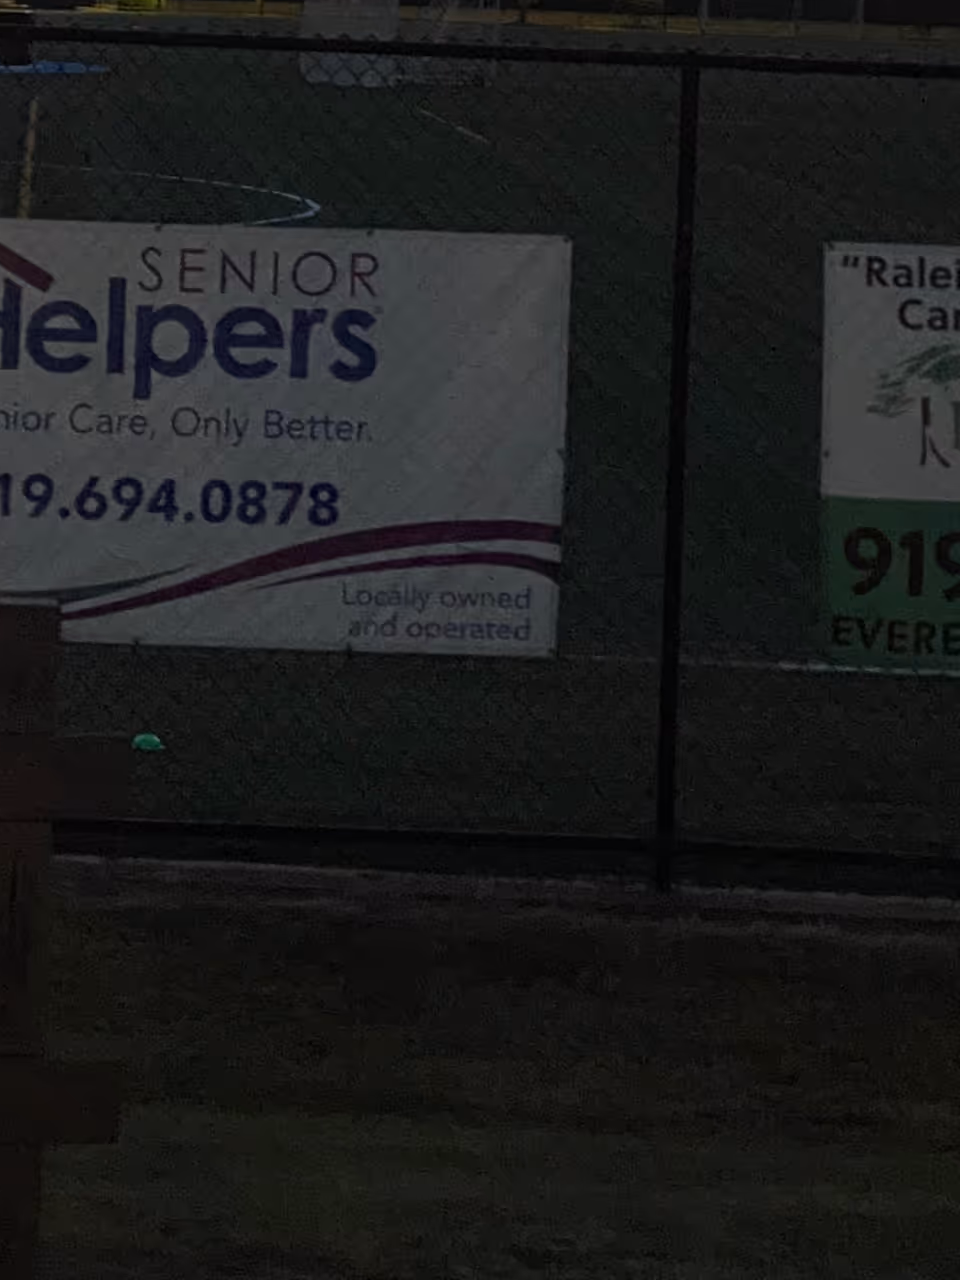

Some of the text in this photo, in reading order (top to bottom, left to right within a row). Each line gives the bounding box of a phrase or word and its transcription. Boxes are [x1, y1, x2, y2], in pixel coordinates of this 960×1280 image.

[137, 246, 379, 297] SENIOR
[69, 403, 157, 440] Care,
[171, 406, 248, 446] Only
[263, 409, 373, 442] Better.
[342, 582, 531, 612] Locally owned
[349, 612, 531, 642] and operated
